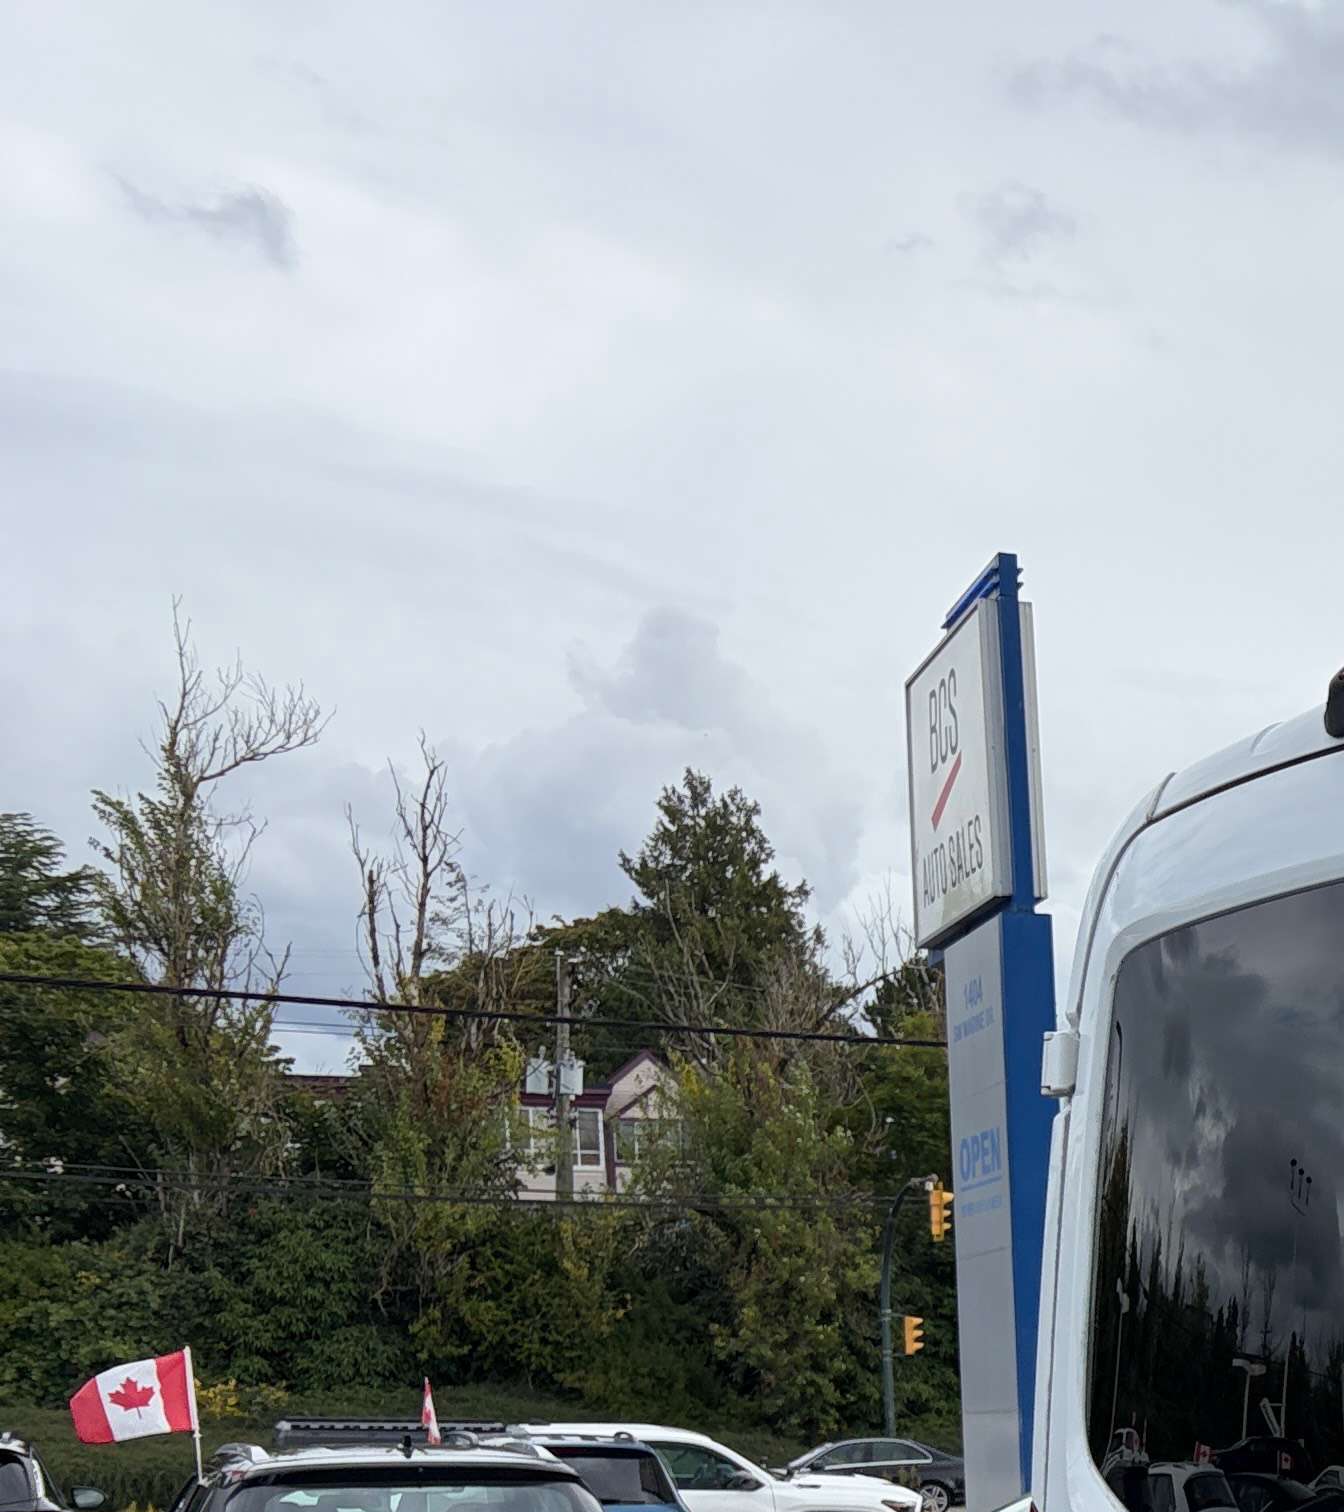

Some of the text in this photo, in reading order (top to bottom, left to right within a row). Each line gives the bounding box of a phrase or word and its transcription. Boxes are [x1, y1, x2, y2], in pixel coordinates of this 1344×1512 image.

[928, 667, 959, 774] BCS
[922, 814, 984, 909] AUTO SALES
[959, 1127, 1002, 1182] OPEN
